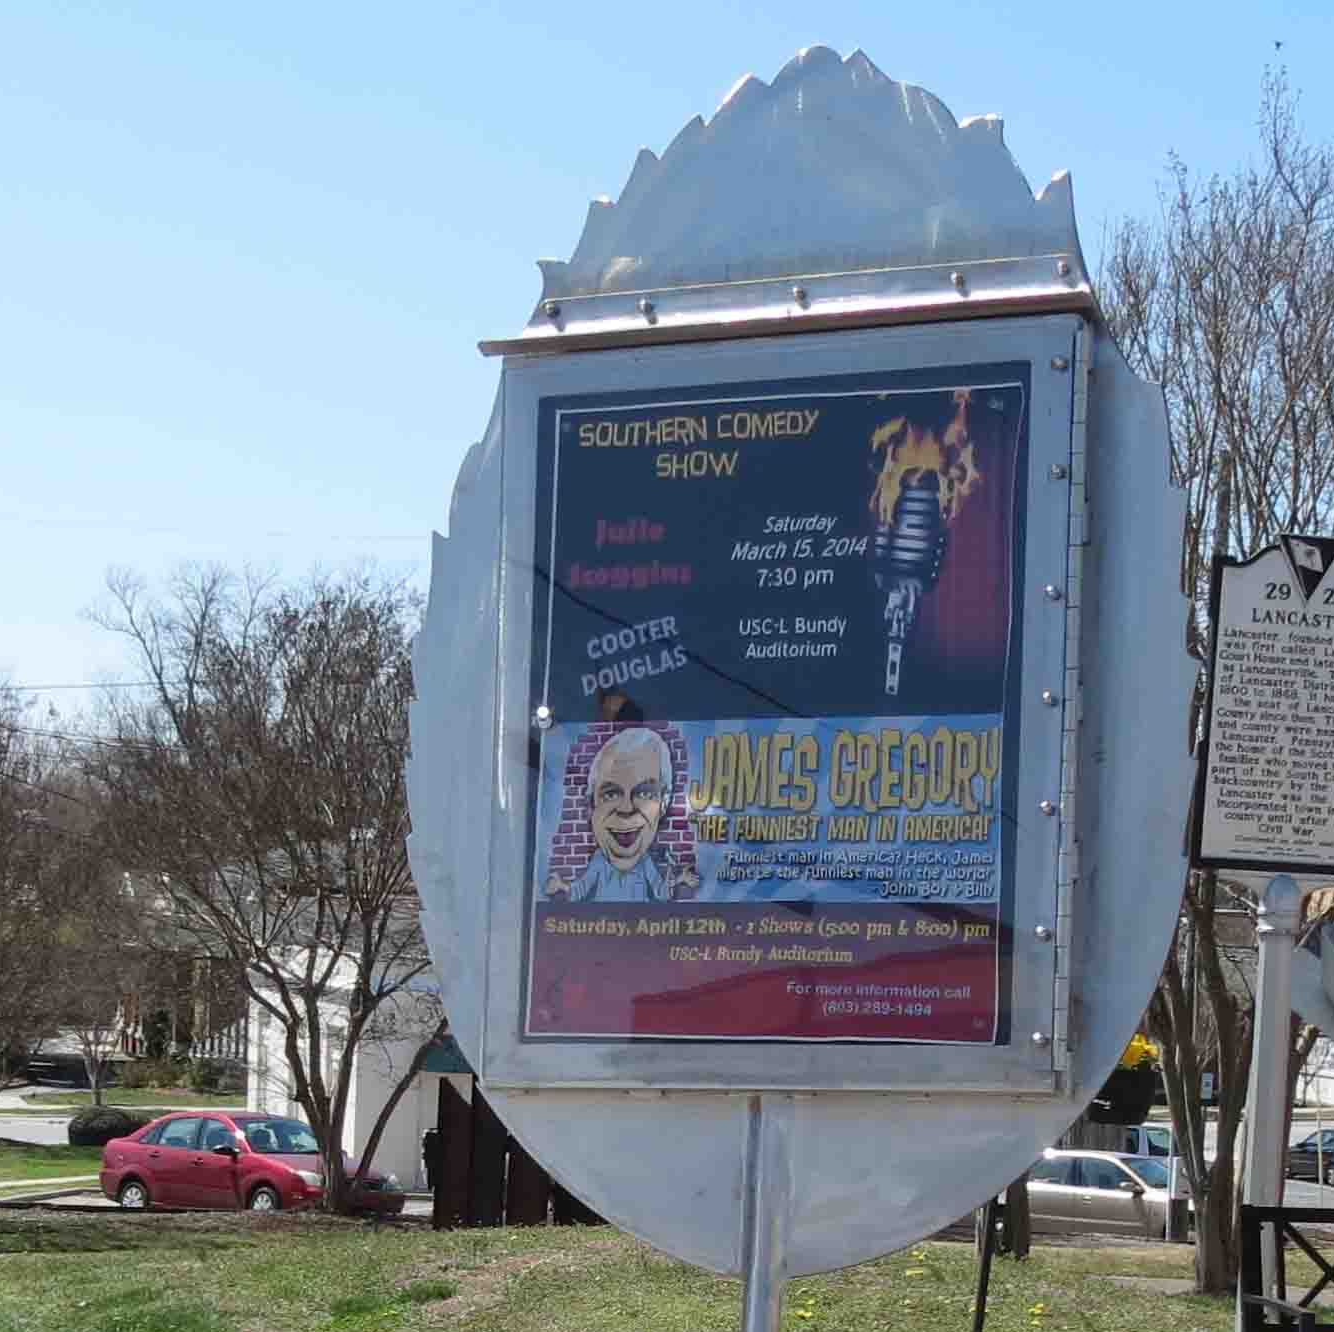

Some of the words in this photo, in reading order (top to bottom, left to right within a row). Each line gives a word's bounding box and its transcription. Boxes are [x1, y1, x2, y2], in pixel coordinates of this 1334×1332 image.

[579, 416, 707, 447] SOUTHERN
[717, 410, 819, 439] COMEDY
[656, 450, 739, 478] SHOW
[763, 514, 837, 534] Saturday
[731, 539, 787, 560] March
[822, 536, 868, 557] 2014
[757, 567, 798, 588] 7:30
[803, 567, 834, 589] pm
[1265, 582, 1292, 600] 29
[586, 615, 679, 660] COOTER
[739, 618, 788, 636] USC-L
[795, 616, 847, 637] Bundy
[745, 641, 837, 660] Auditorium
[580, 645, 688, 696] DOUGLAS
[689, 729, 819, 812] JAMES
[830, 726, 1000, 812] GREGORY
[734, 816, 824, 841] FUNNIEST
[827, 816, 869, 841] MAN
[875, 816, 896, 841] IN
[787, 850, 814, 864] man
[818, 850, 834, 864] in
[951, 849, 994, 865] James
[716, 866, 754, 883] might
[779, 865, 800, 880] the
[805, 864, 861, 882] funniest
[866, 865, 893, 880] man
[898, 865, 910, 879] in
[914, 865, 939, 880] the
[544, 917, 631, 937] Saturday,
[636, 917, 680, 937] April
[685, 918, 727, 935] 12th
[758, 916, 813, 935] Shows
[867, 923, 892, 940] pm
[897, 919, 909, 937] &
[963, 924, 990, 942] pm
[717, 945, 763, 964] Bundy
[768, 944, 853, 963] Auditorium
[786, 981, 811, 994] For
[816, 983, 852, 995] more
[856, 983, 940, 999] information
[944, 985, 971, 999] call
